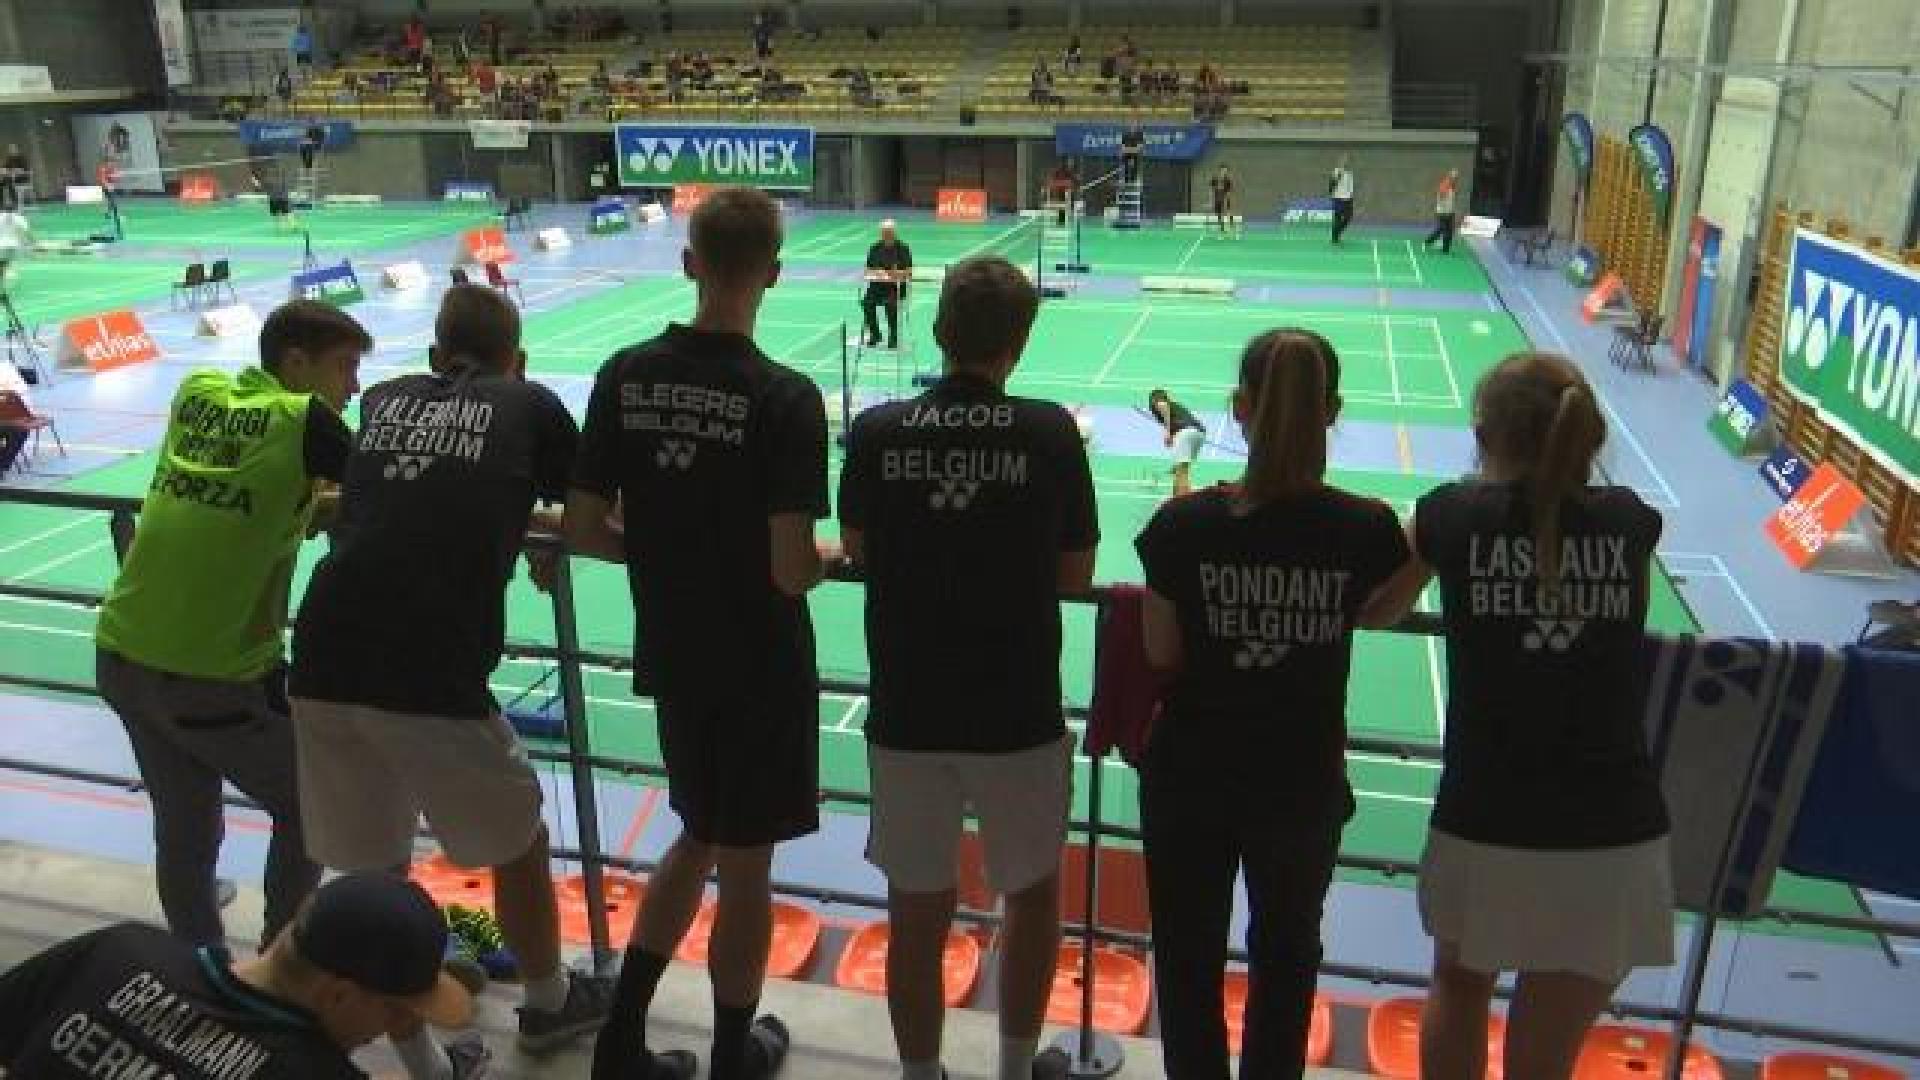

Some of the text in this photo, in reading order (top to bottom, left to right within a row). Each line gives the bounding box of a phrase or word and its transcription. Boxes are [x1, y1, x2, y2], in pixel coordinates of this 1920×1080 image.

[693, 137, 799, 175] YONEX
[1848, 290, 1920, 437] YON
[369, 396, 493, 432] LALLEMAND
[622, 382, 749, 421] SLEGERS
[902, 404, 1015, 427] JACOB
[360, 426, 484, 463] BELGIUM
[881, 447, 1028, 487] BELGIUM
[1469, 534, 1628, 578] LASAUX
[1200, 563, 1352, 609] PONDANT
[1472, 581, 1630, 619] BELGIUM
[51, 1012, 175, 1080] GERM
